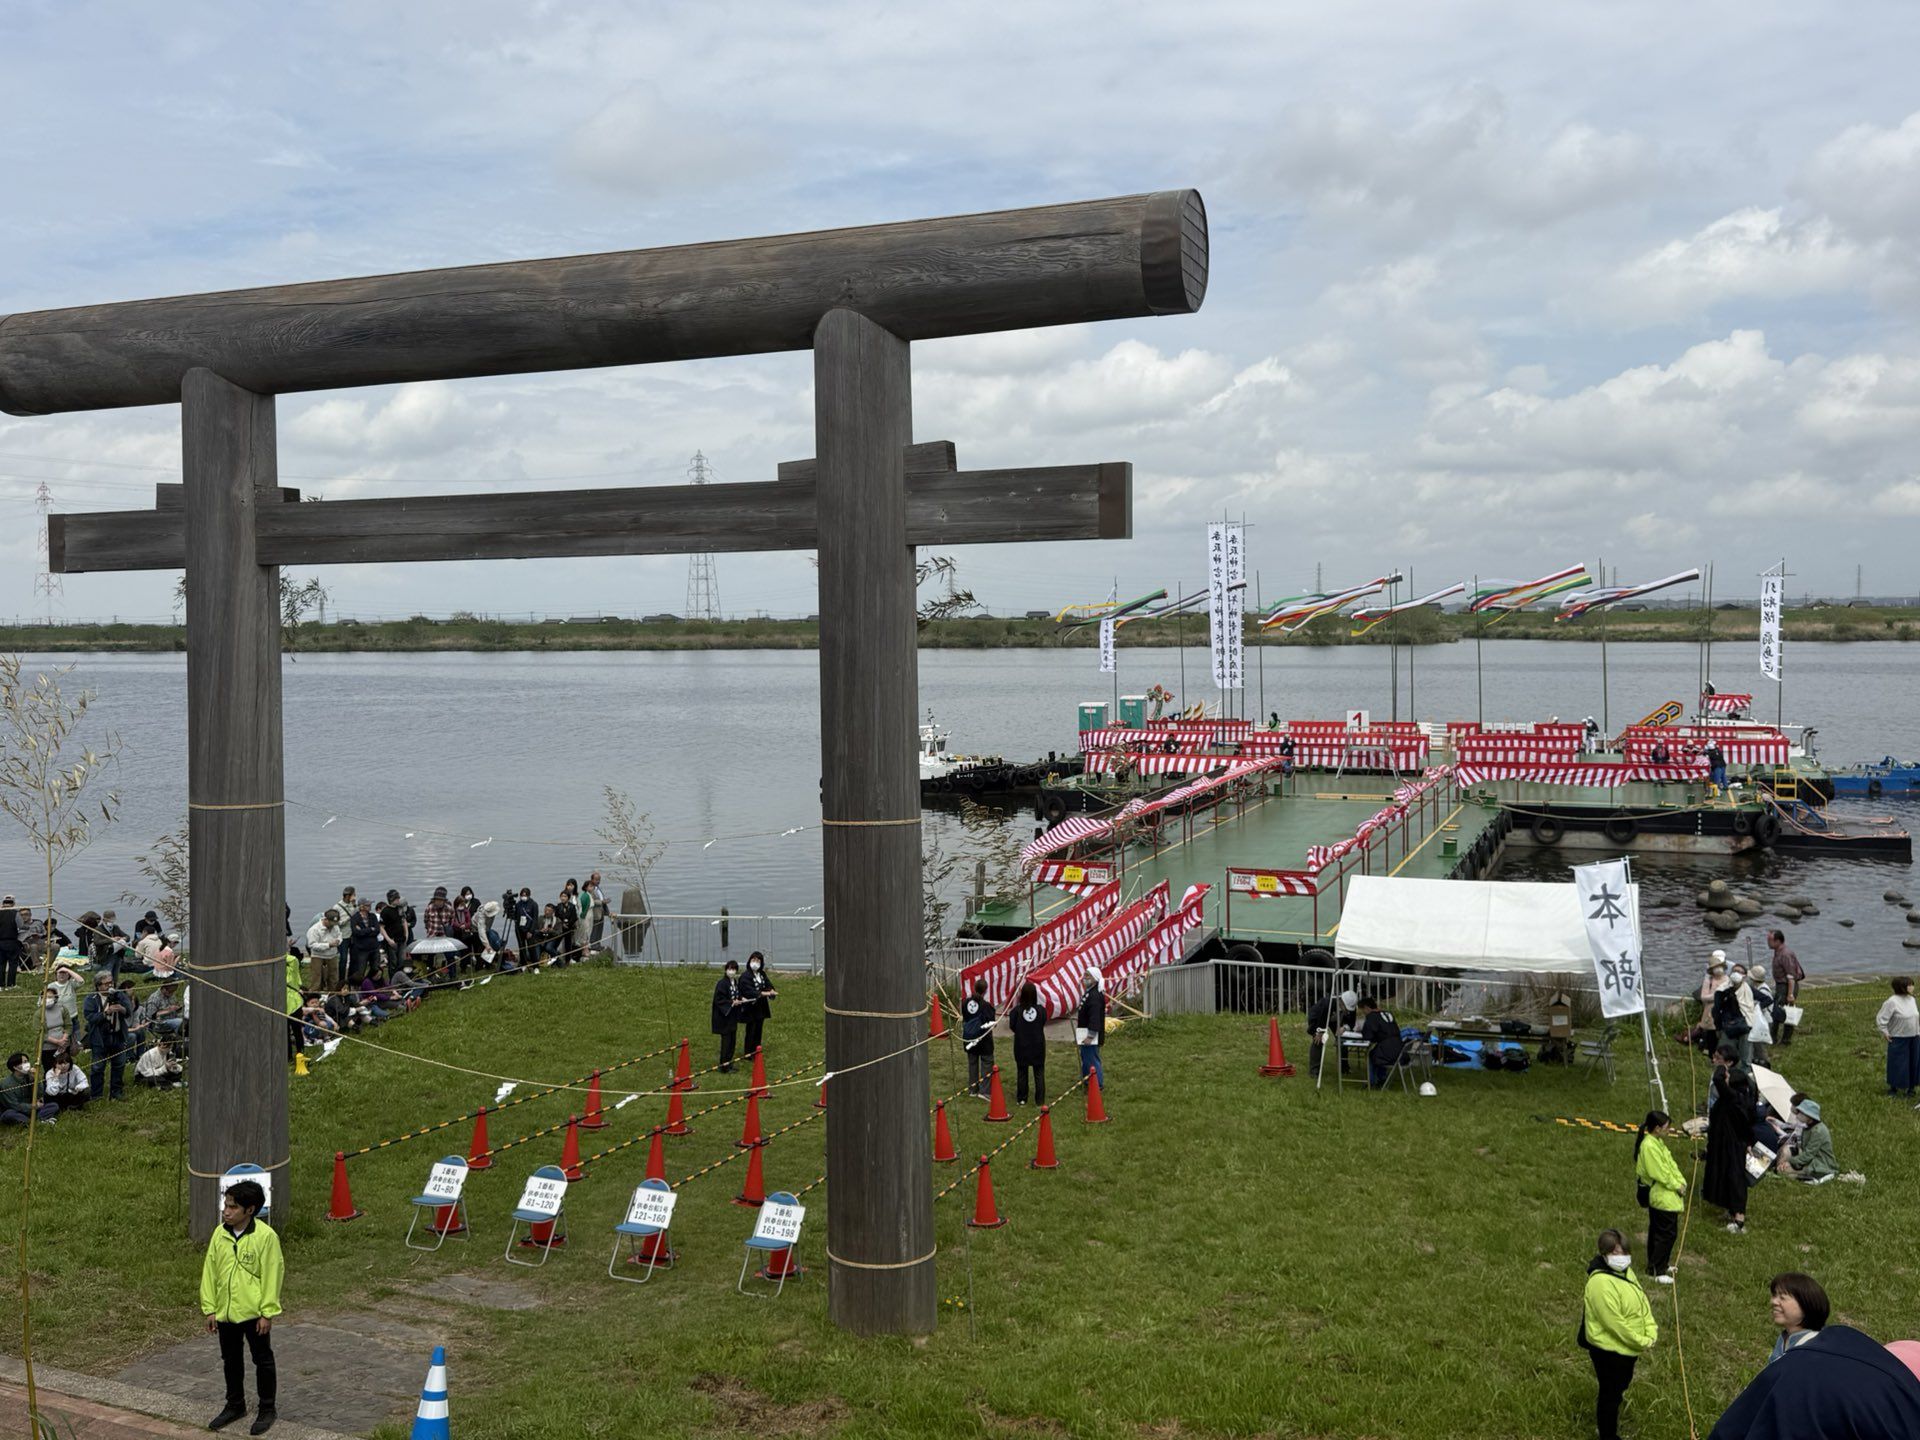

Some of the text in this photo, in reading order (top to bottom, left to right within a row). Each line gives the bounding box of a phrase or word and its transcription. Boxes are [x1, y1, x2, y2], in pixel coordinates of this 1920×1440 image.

[1352, 712, 1362, 732] 1
[442, 1167, 458, 1176] 1番船
[538, 1182, 556, 1190] 1番船
[646, 1193, 664, 1203] 1番船
[775, 1208, 793, 1217] 1番船
